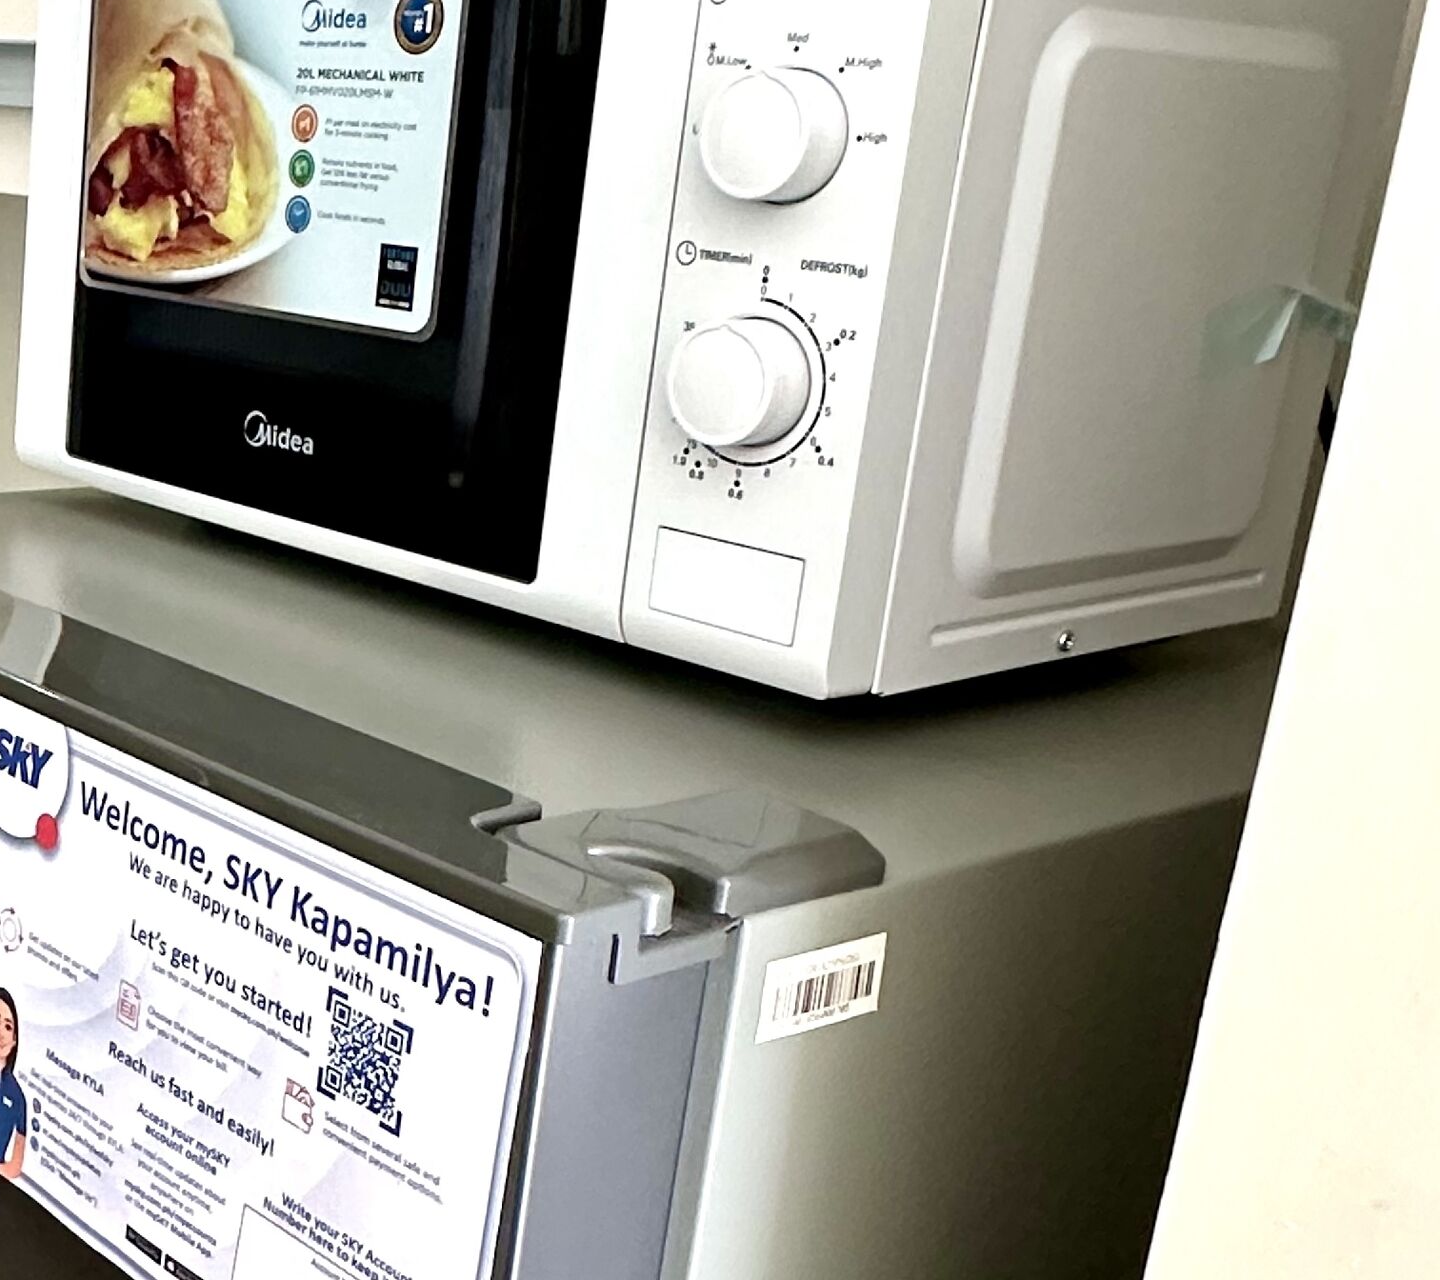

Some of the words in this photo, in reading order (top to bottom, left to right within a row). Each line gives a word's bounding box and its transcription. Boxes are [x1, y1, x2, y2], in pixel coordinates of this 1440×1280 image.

[413, 2, 436, 34] #1
[787, 32, 809, 43] Med
[317, 69, 385, 81] MECHANICAL
[389, 70, 424, 83] WHITE
[863, 132, 887, 144] High
[801, 260, 868, 279] DEFROST(kg)
[810, 313, 816, 323] 2
[829, 372, 836, 383] 4
[244, 410, 314, 455] Midea
[81, 781, 212, 885] Welcome,
[223, 854, 283, 910] SKY
[290, 885, 494, 1017] Kapamilya!
[129, 851, 151, 880] We
[155, 871, 178, 893] are
[182, 879, 230, 925] happy
[234, 908, 251, 930] to
[255, 916, 292, 954] have
[297, 943, 328, 972] you
[334, 961, 373, 996] with
[380, 985, 406, 1012] us.
[130, 919, 166, 956] Let's
[170, 947, 199, 974] get
[204, 963, 236, 994] you
[241, 983, 311, 1037] started!
[45, 1048, 81, 1081] Message
[108, 1041, 147, 1078] Reach
[150, 1070, 166, 1089] us
[168, 1076, 194, 1108] fast
[197, 1095, 225, 1125] and
[227, 1116, 275, 1158] easily!
[136, 1102, 170, 1130] Access
[170, 1123, 195, 1146] your
[145, 1125, 184, 1156] account
[185, 1149, 217, 1176] online
[263, 1196, 307, 1236] Number
[309, 1224, 334, 1252] here
[336, 1243, 349, 1261] to
[282, 1192, 312, 1222] Write
[312, 1212, 340, 1239] your
[341, 1231, 364, 1254] SKY
